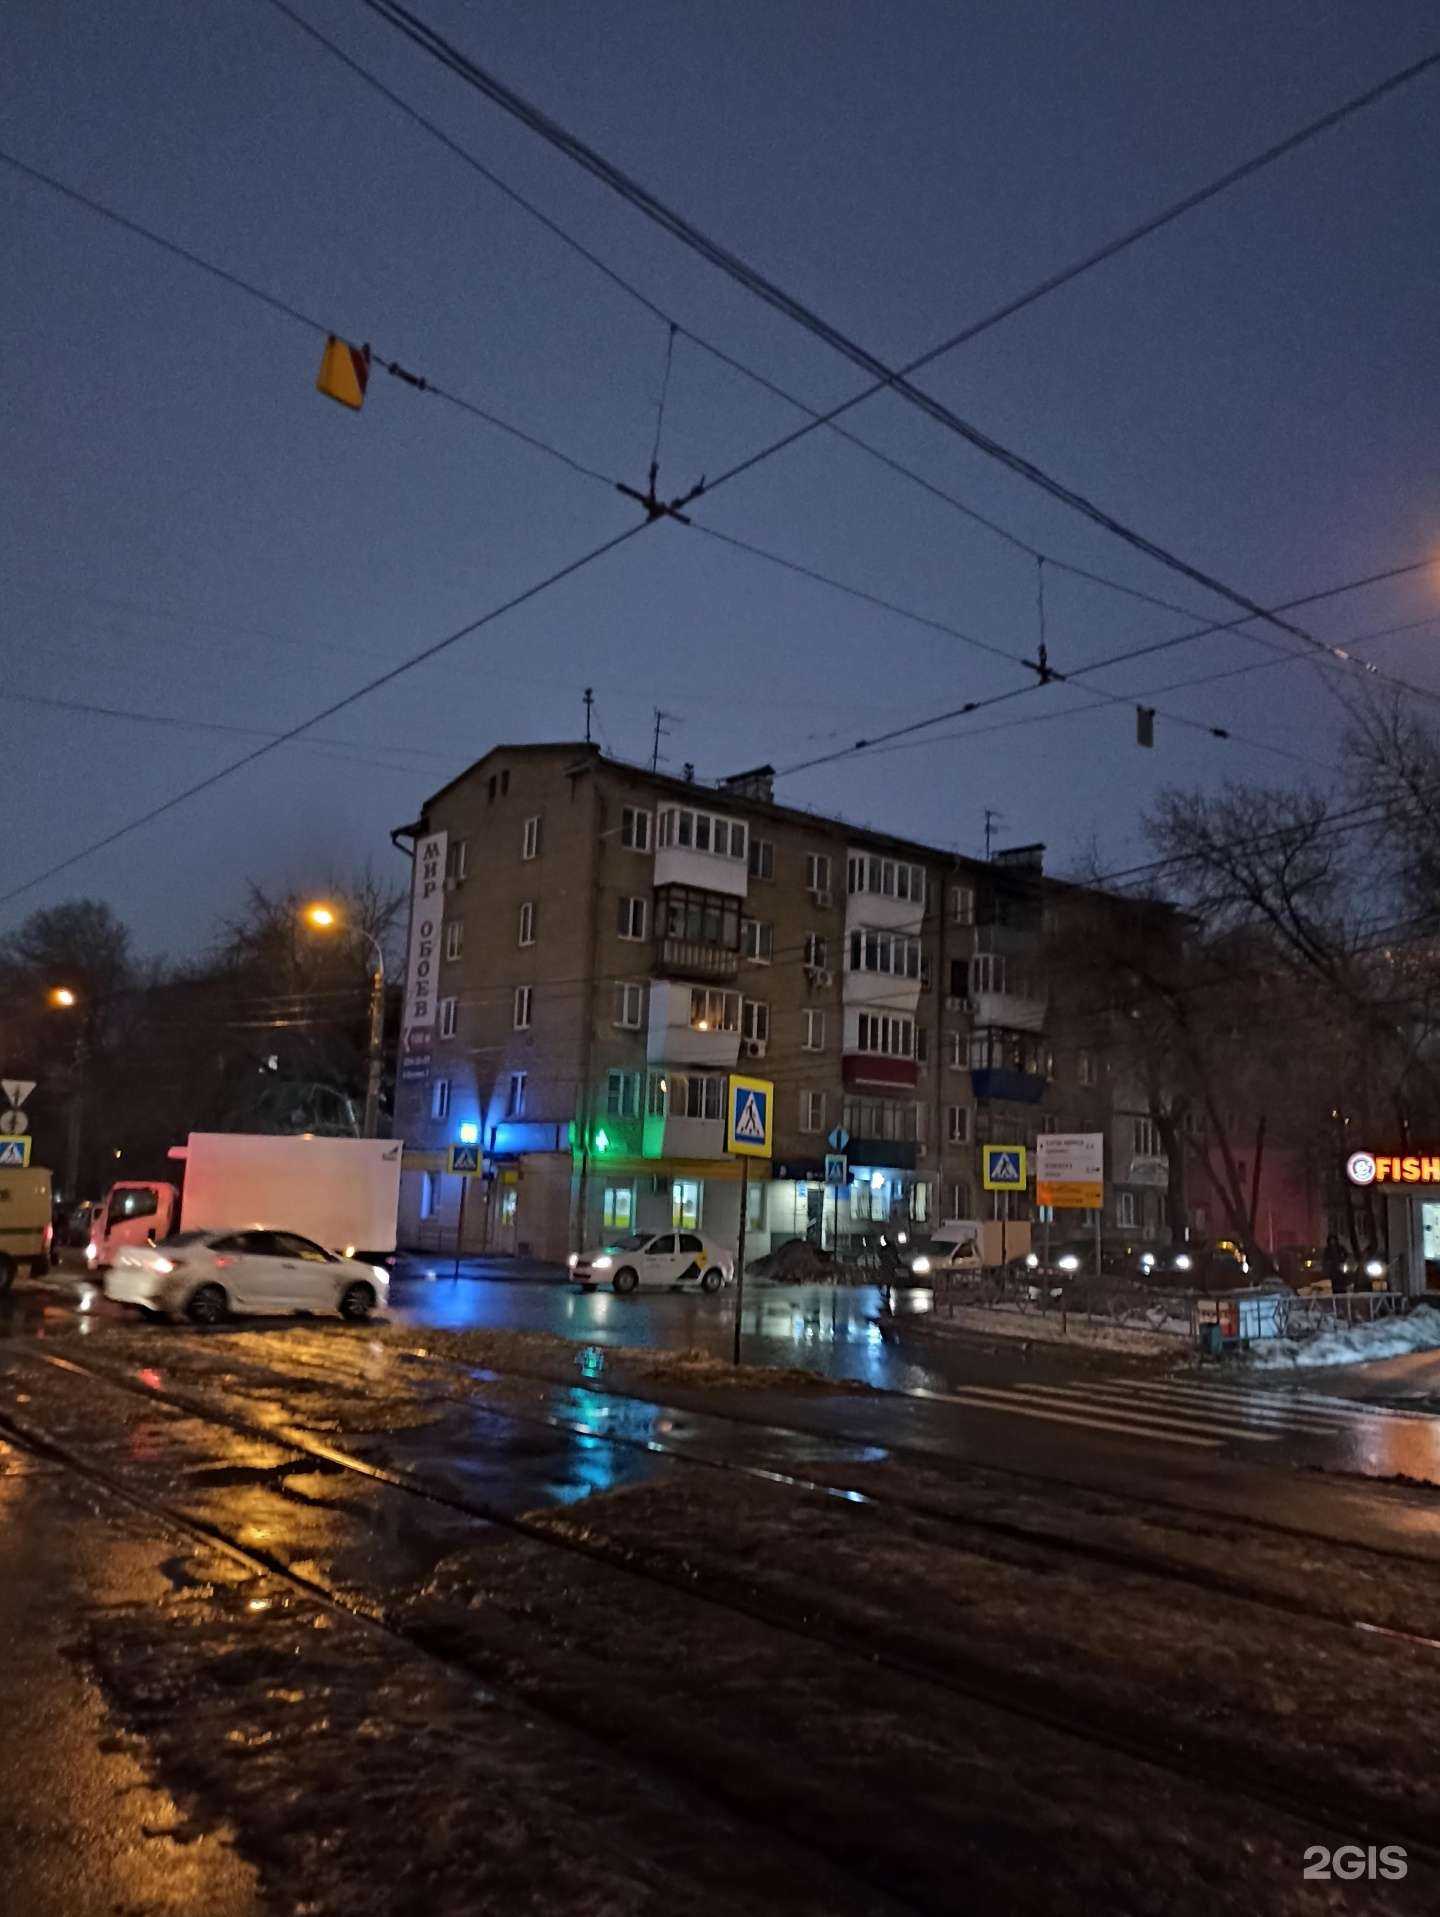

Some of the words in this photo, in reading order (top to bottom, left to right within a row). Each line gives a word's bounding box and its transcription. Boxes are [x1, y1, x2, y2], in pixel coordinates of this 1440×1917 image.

[423, 842, 440, 900] МИР
[413, 920, 434, 1018] ОБОЕВ
[1375, 1156, 1440, 1182] FISH
